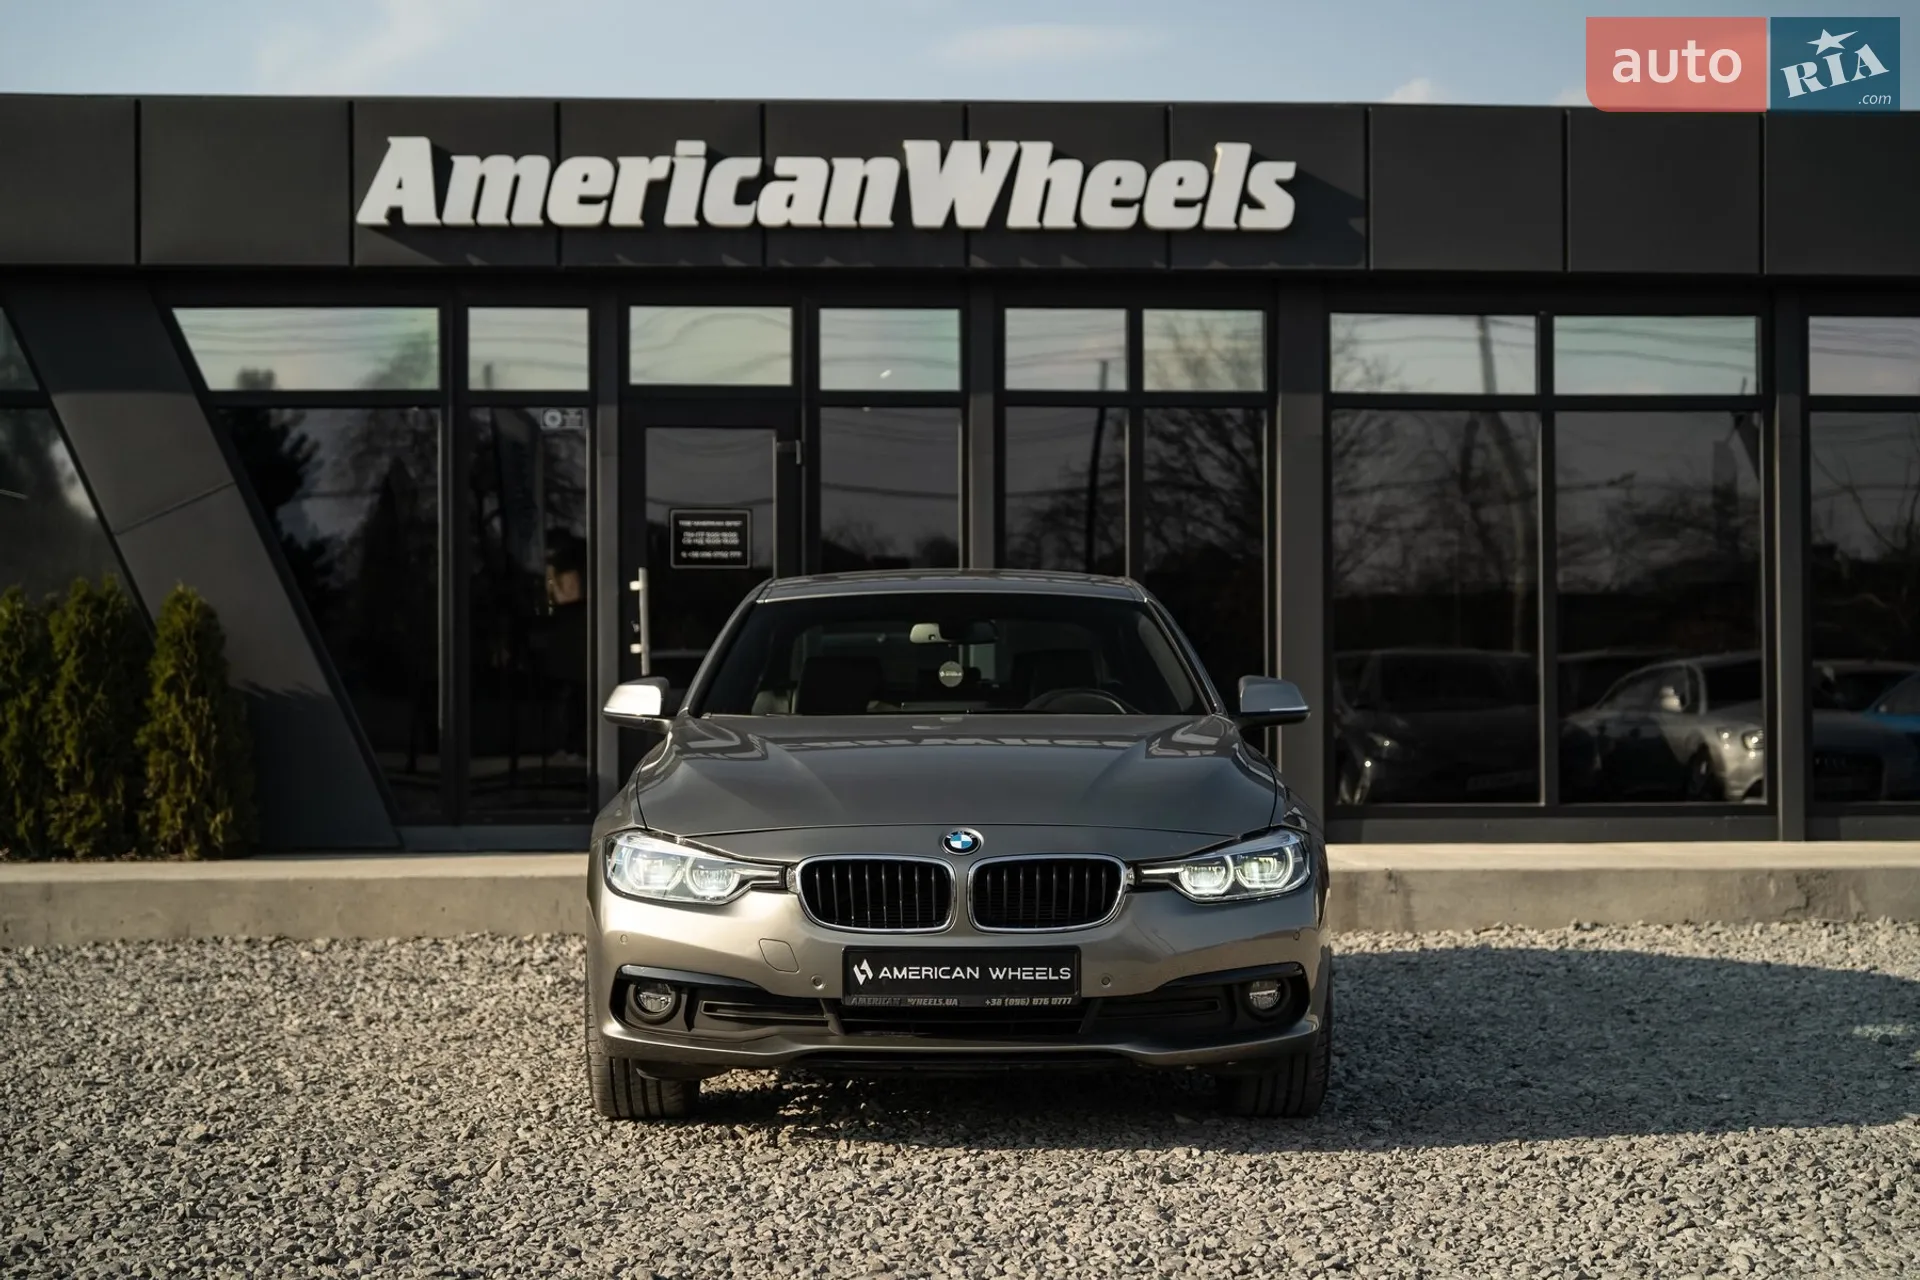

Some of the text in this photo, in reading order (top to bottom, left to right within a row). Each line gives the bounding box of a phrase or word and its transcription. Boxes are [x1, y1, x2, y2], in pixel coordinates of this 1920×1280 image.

[356, 136, 1297, 231] AmericanWheels
[878, 966, 1071, 980] AMERICAN WHEELS
